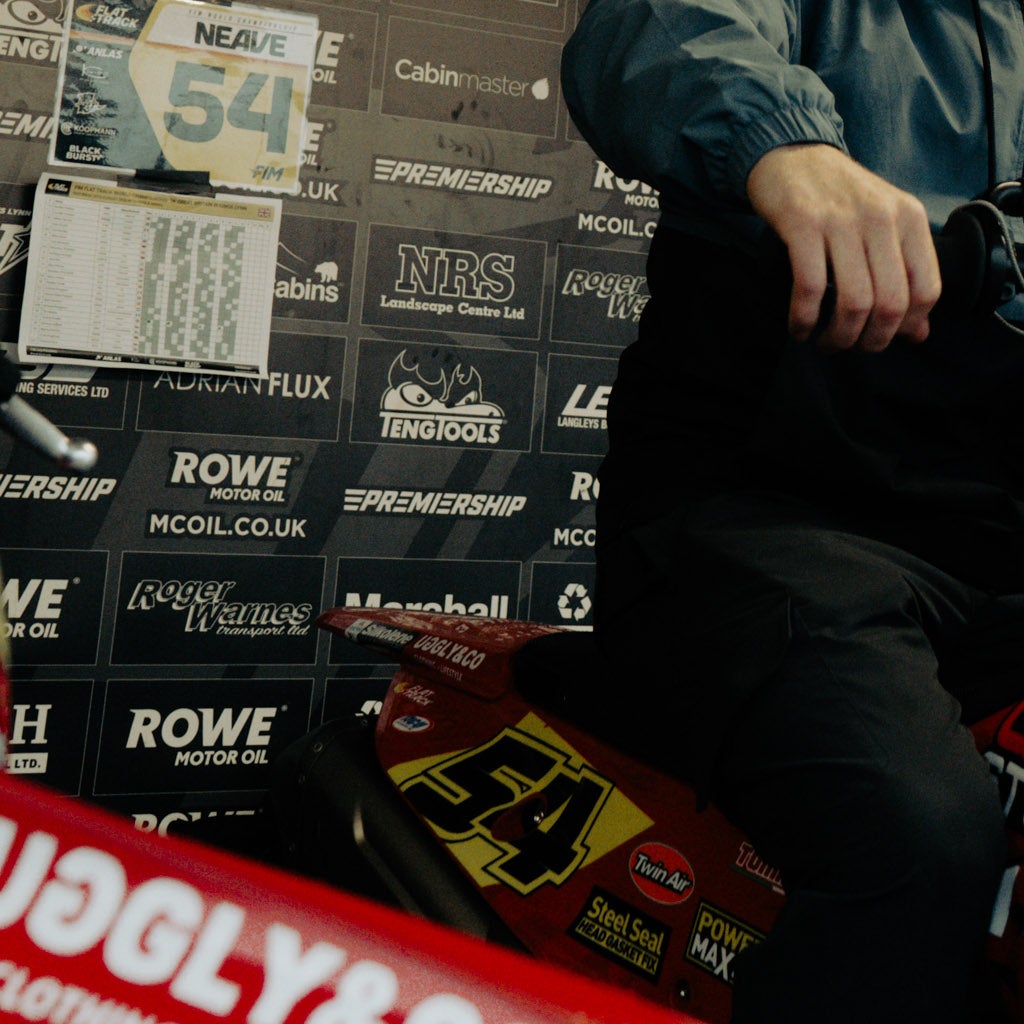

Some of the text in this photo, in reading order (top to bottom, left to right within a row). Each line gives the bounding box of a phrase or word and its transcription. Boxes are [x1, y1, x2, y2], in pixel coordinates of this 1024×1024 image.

[96, 4, 127, 17] FLAT
[87, 47, 122, 60] ANLAS
[194, 21, 286, 58] NEAVE
[395, 59, 529, 98] Cabinmaster
[163, 60, 294, 154] 54
[69, 144, 101, 154] BLACK
[252, 164, 284, 181] FIM
[374, 158, 552, 199] PREMIERSHIP
[396, 243, 515, 302] NRS
[380, 295, 525, 320] Landscape Centre Ltd
[37, 383, 109, 398] SERVICES LTD
[558, 417, 598, 428] LANGLEYS
[171, 451, 293, 488] ROWE
[210, 487, 285, 503] MOTOR OIL
[344, 488, 527, 517] PREMIERSHIP
[151, 514, 307, 538] MCOIL.CO.UK
[127, 579, 236, 610] Roger
[28, 622, 59, 638] OIL
[184, 602, 312, 632] Warnes
[126, 707, 278, 748] ROWE
[15, 758, 41, 769] LTD.
[174, 750, 269, 766] MOTOR OIL
[401, 727, 613, 895] 54
[634, 853, 691, 893] Twin Air
[587, 895, 665, 955] Steel Seal
[577, 919, 607, 942] HEAD
[642, 957, 659, 975] FIX
